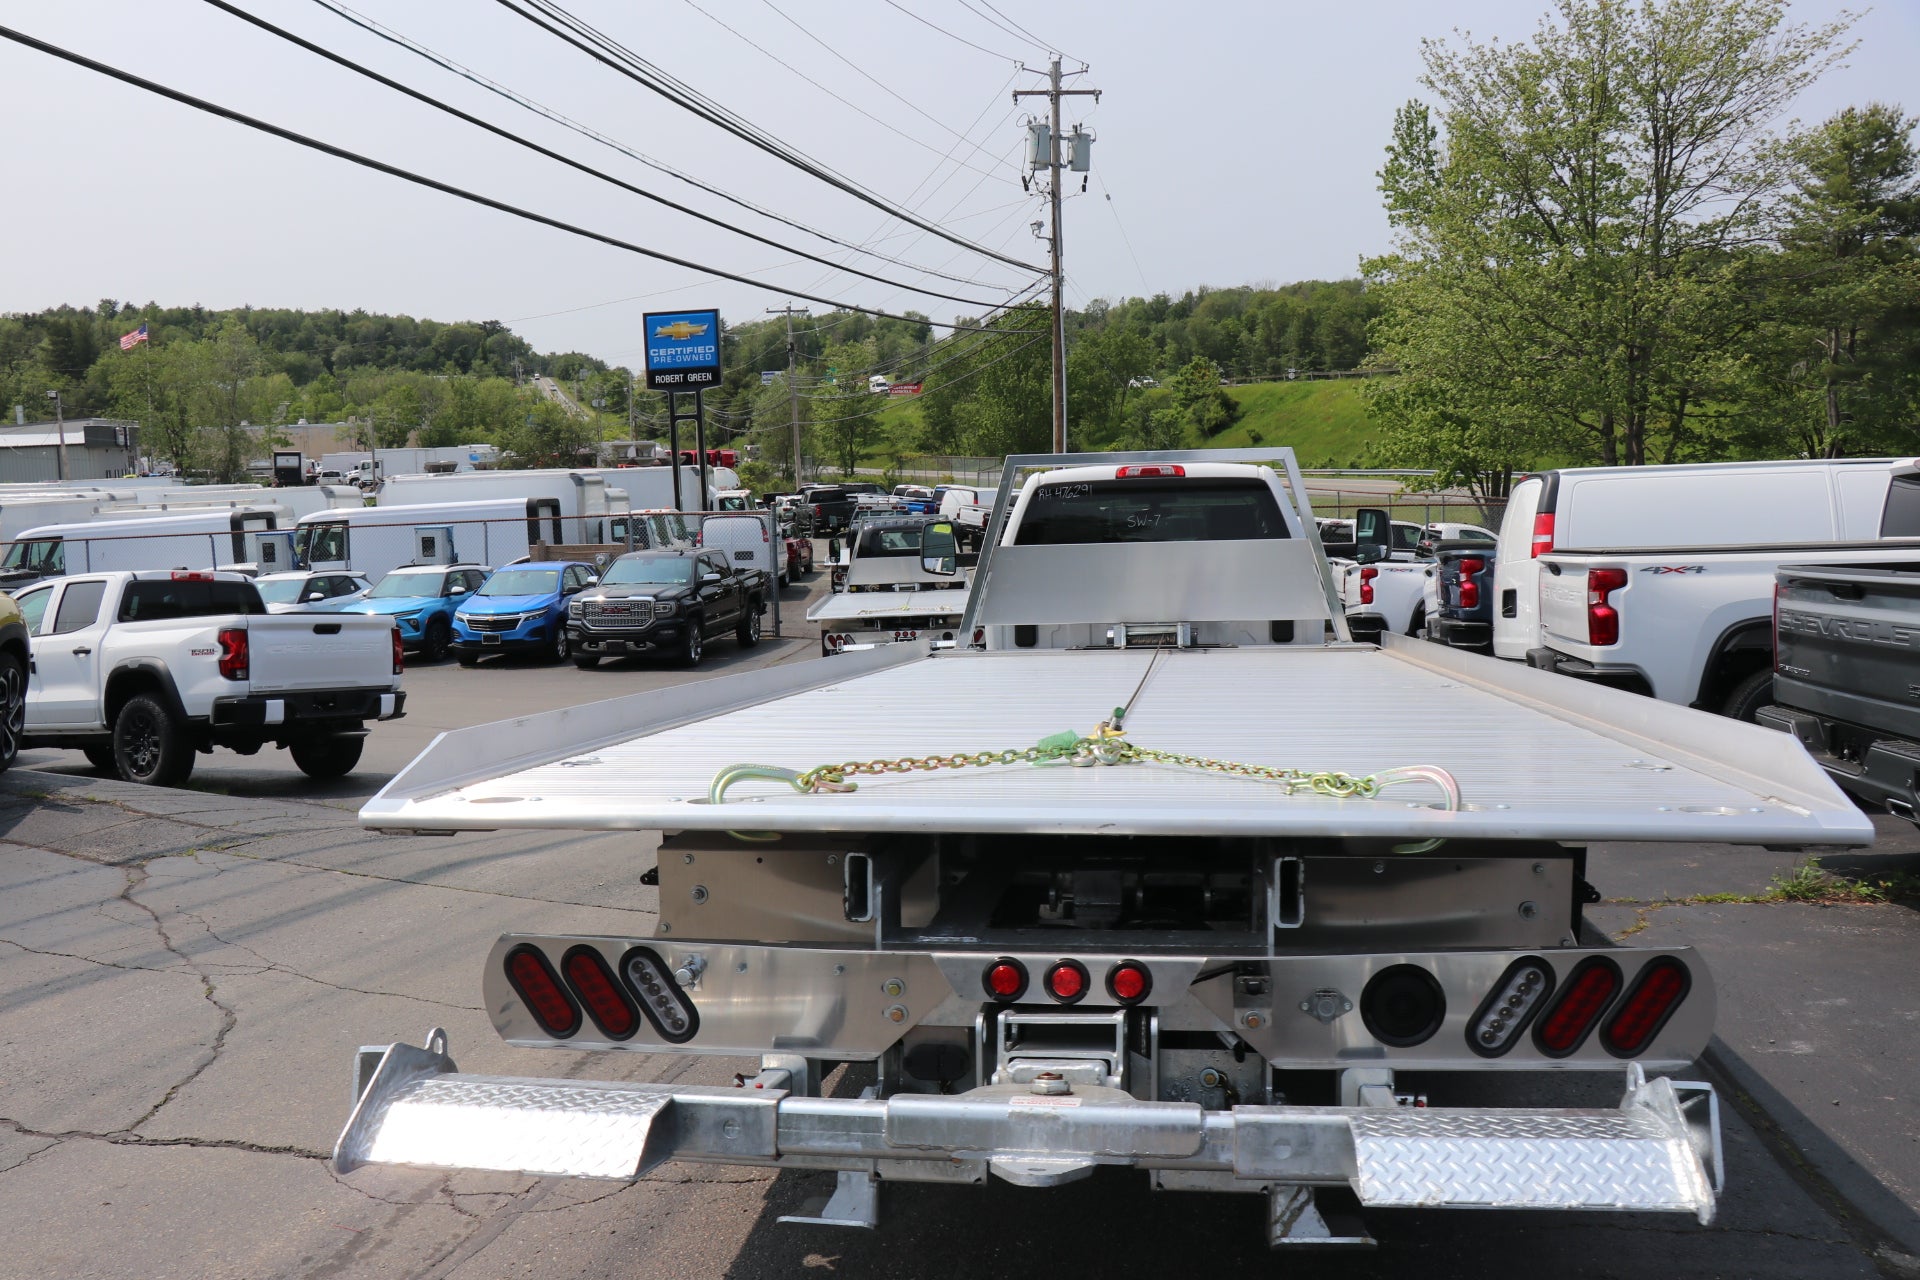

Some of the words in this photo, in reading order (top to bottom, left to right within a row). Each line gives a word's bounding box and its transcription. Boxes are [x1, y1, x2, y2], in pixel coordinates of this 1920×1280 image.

[649, 345, 715, 357] CERTIFIED
[653, 353, 712, 364] PRE-OWNED
[655, 374, 684, 384] ROBERT
[687, 372, 712, 382] GREEN
